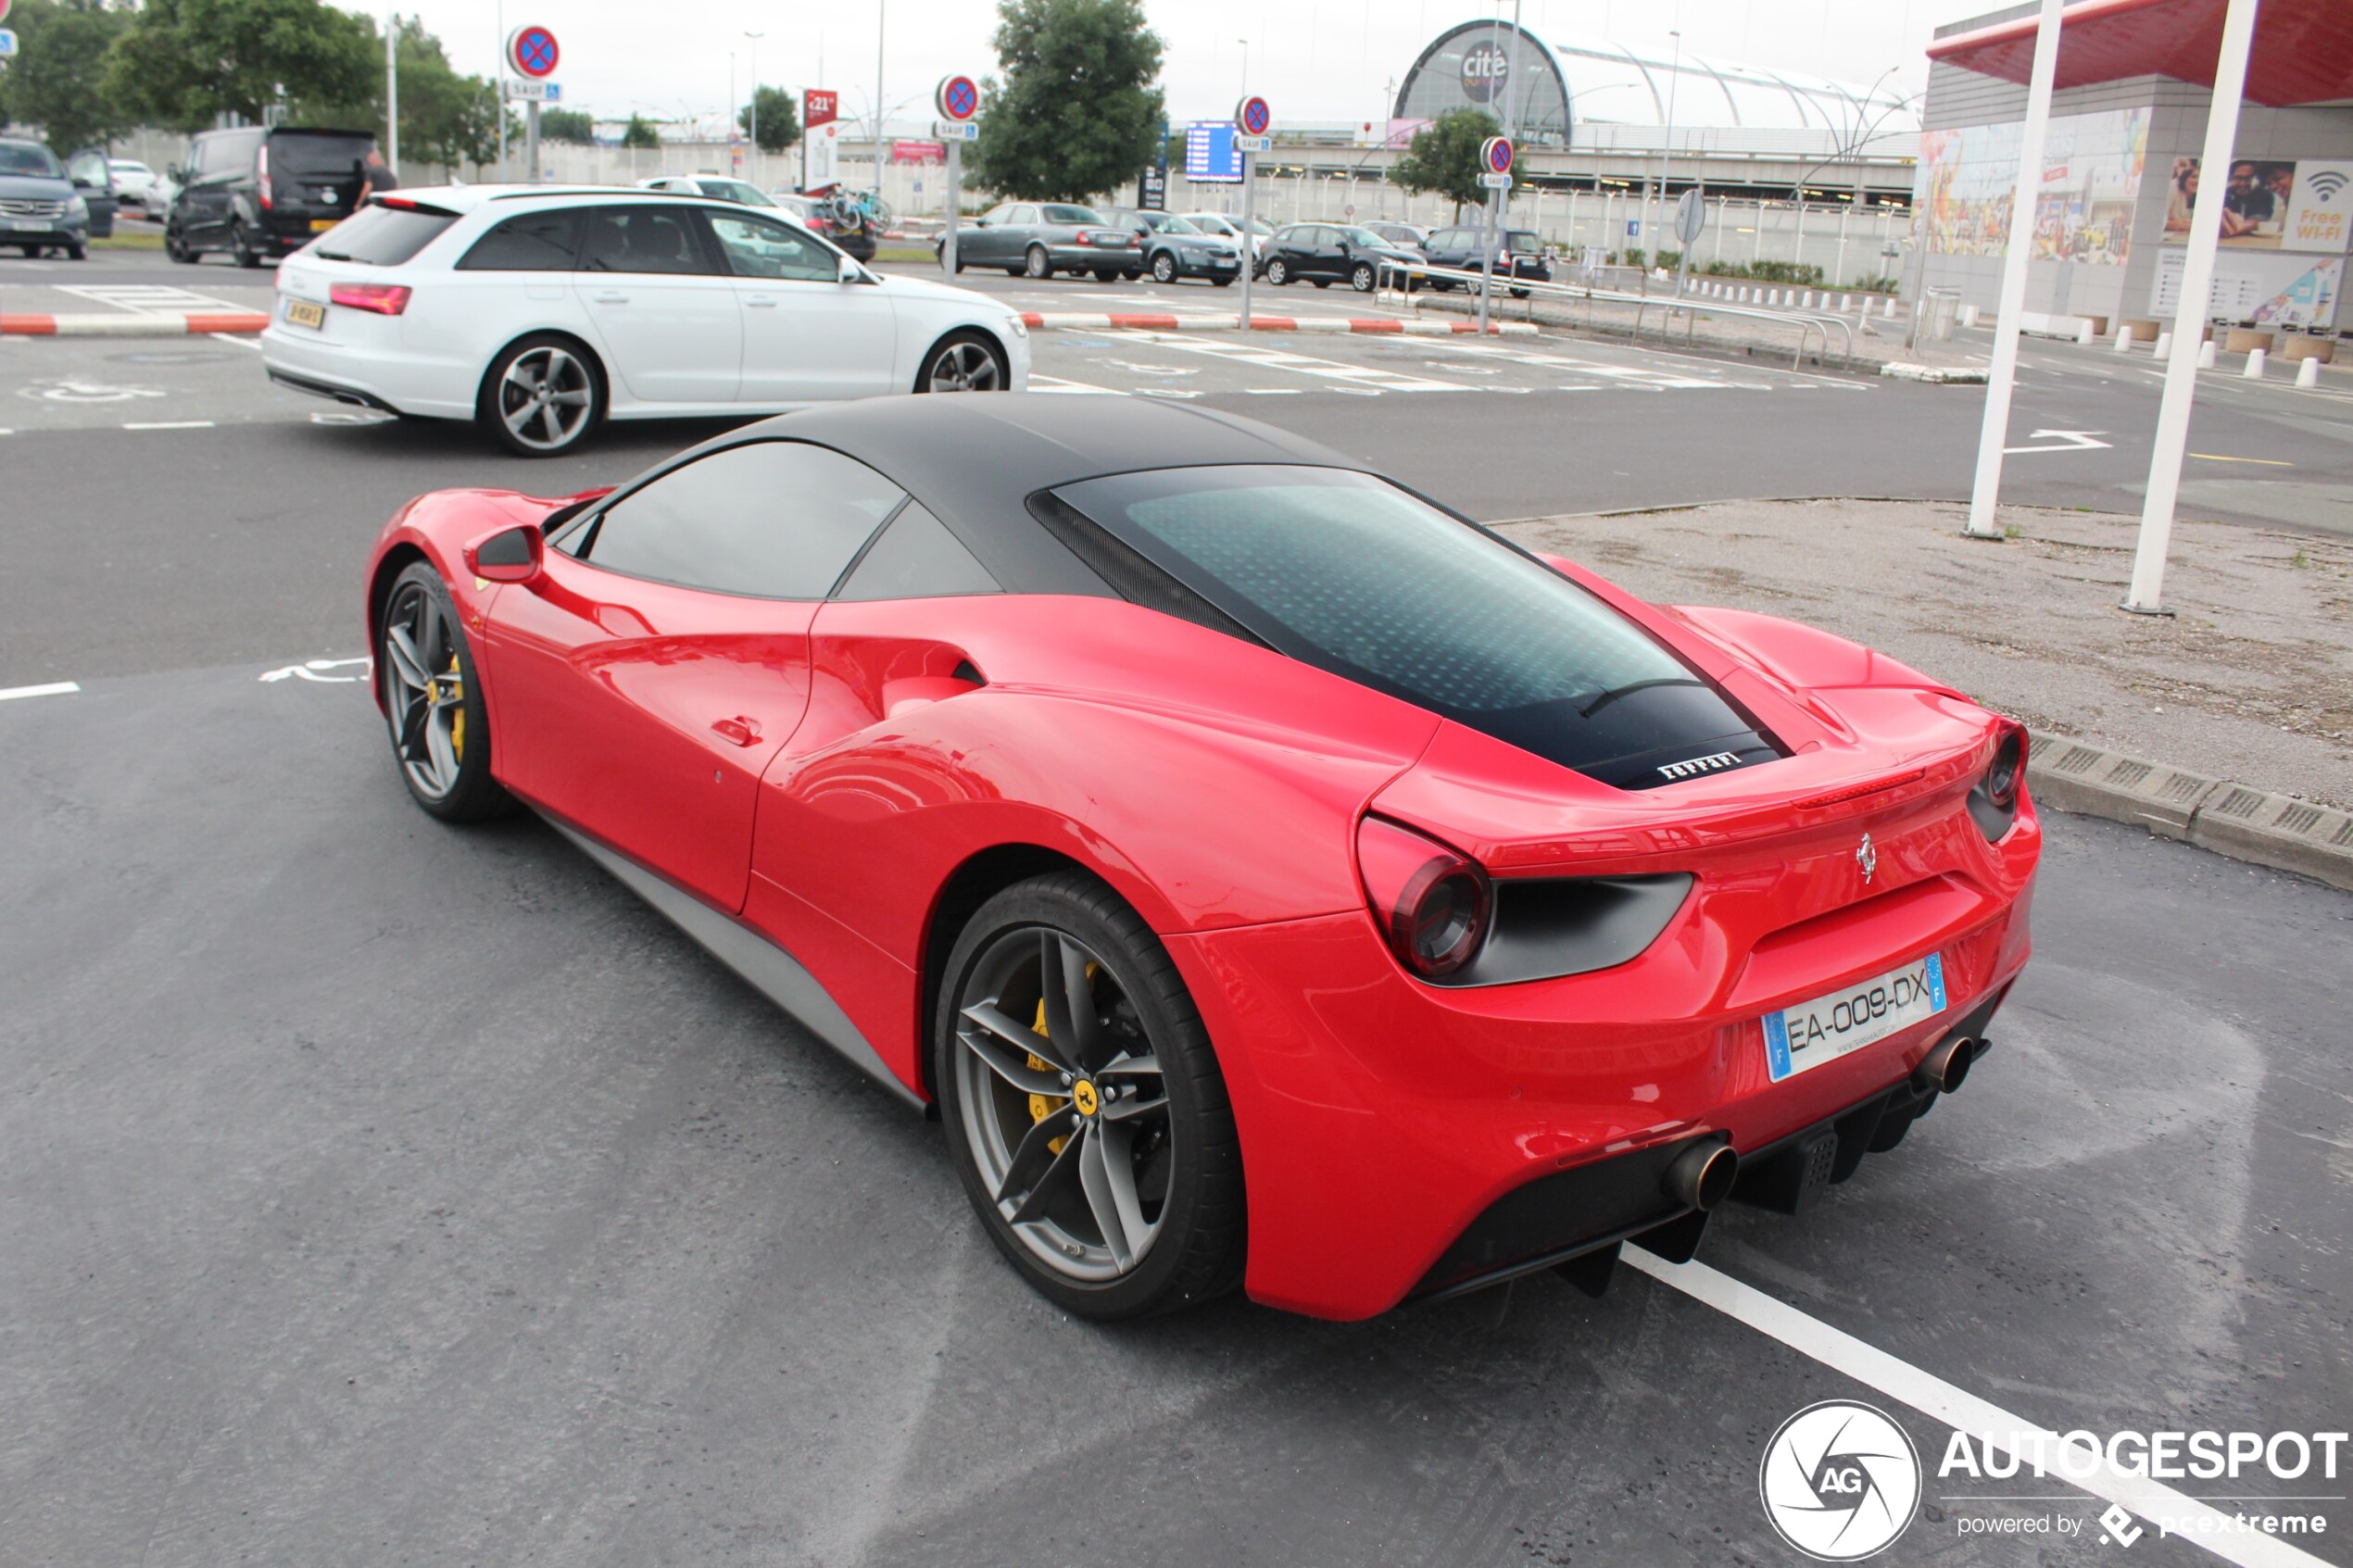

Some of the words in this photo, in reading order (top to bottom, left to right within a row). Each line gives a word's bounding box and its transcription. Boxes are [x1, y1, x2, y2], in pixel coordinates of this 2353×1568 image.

[1463, 49, 1506, 77] cité
[941, 125, 963, 134] SAUF
[1242, 138, 1259, 148] SAUF
[2300, 209, 2342, 223] Free
[1657, 751, 1743, 780] Ferrari
[1776, 1049, 1781, 1064] F
[1787, 968, 1930, 1052] EA-009-DX
[1933, 986, 1940, 1002] F
